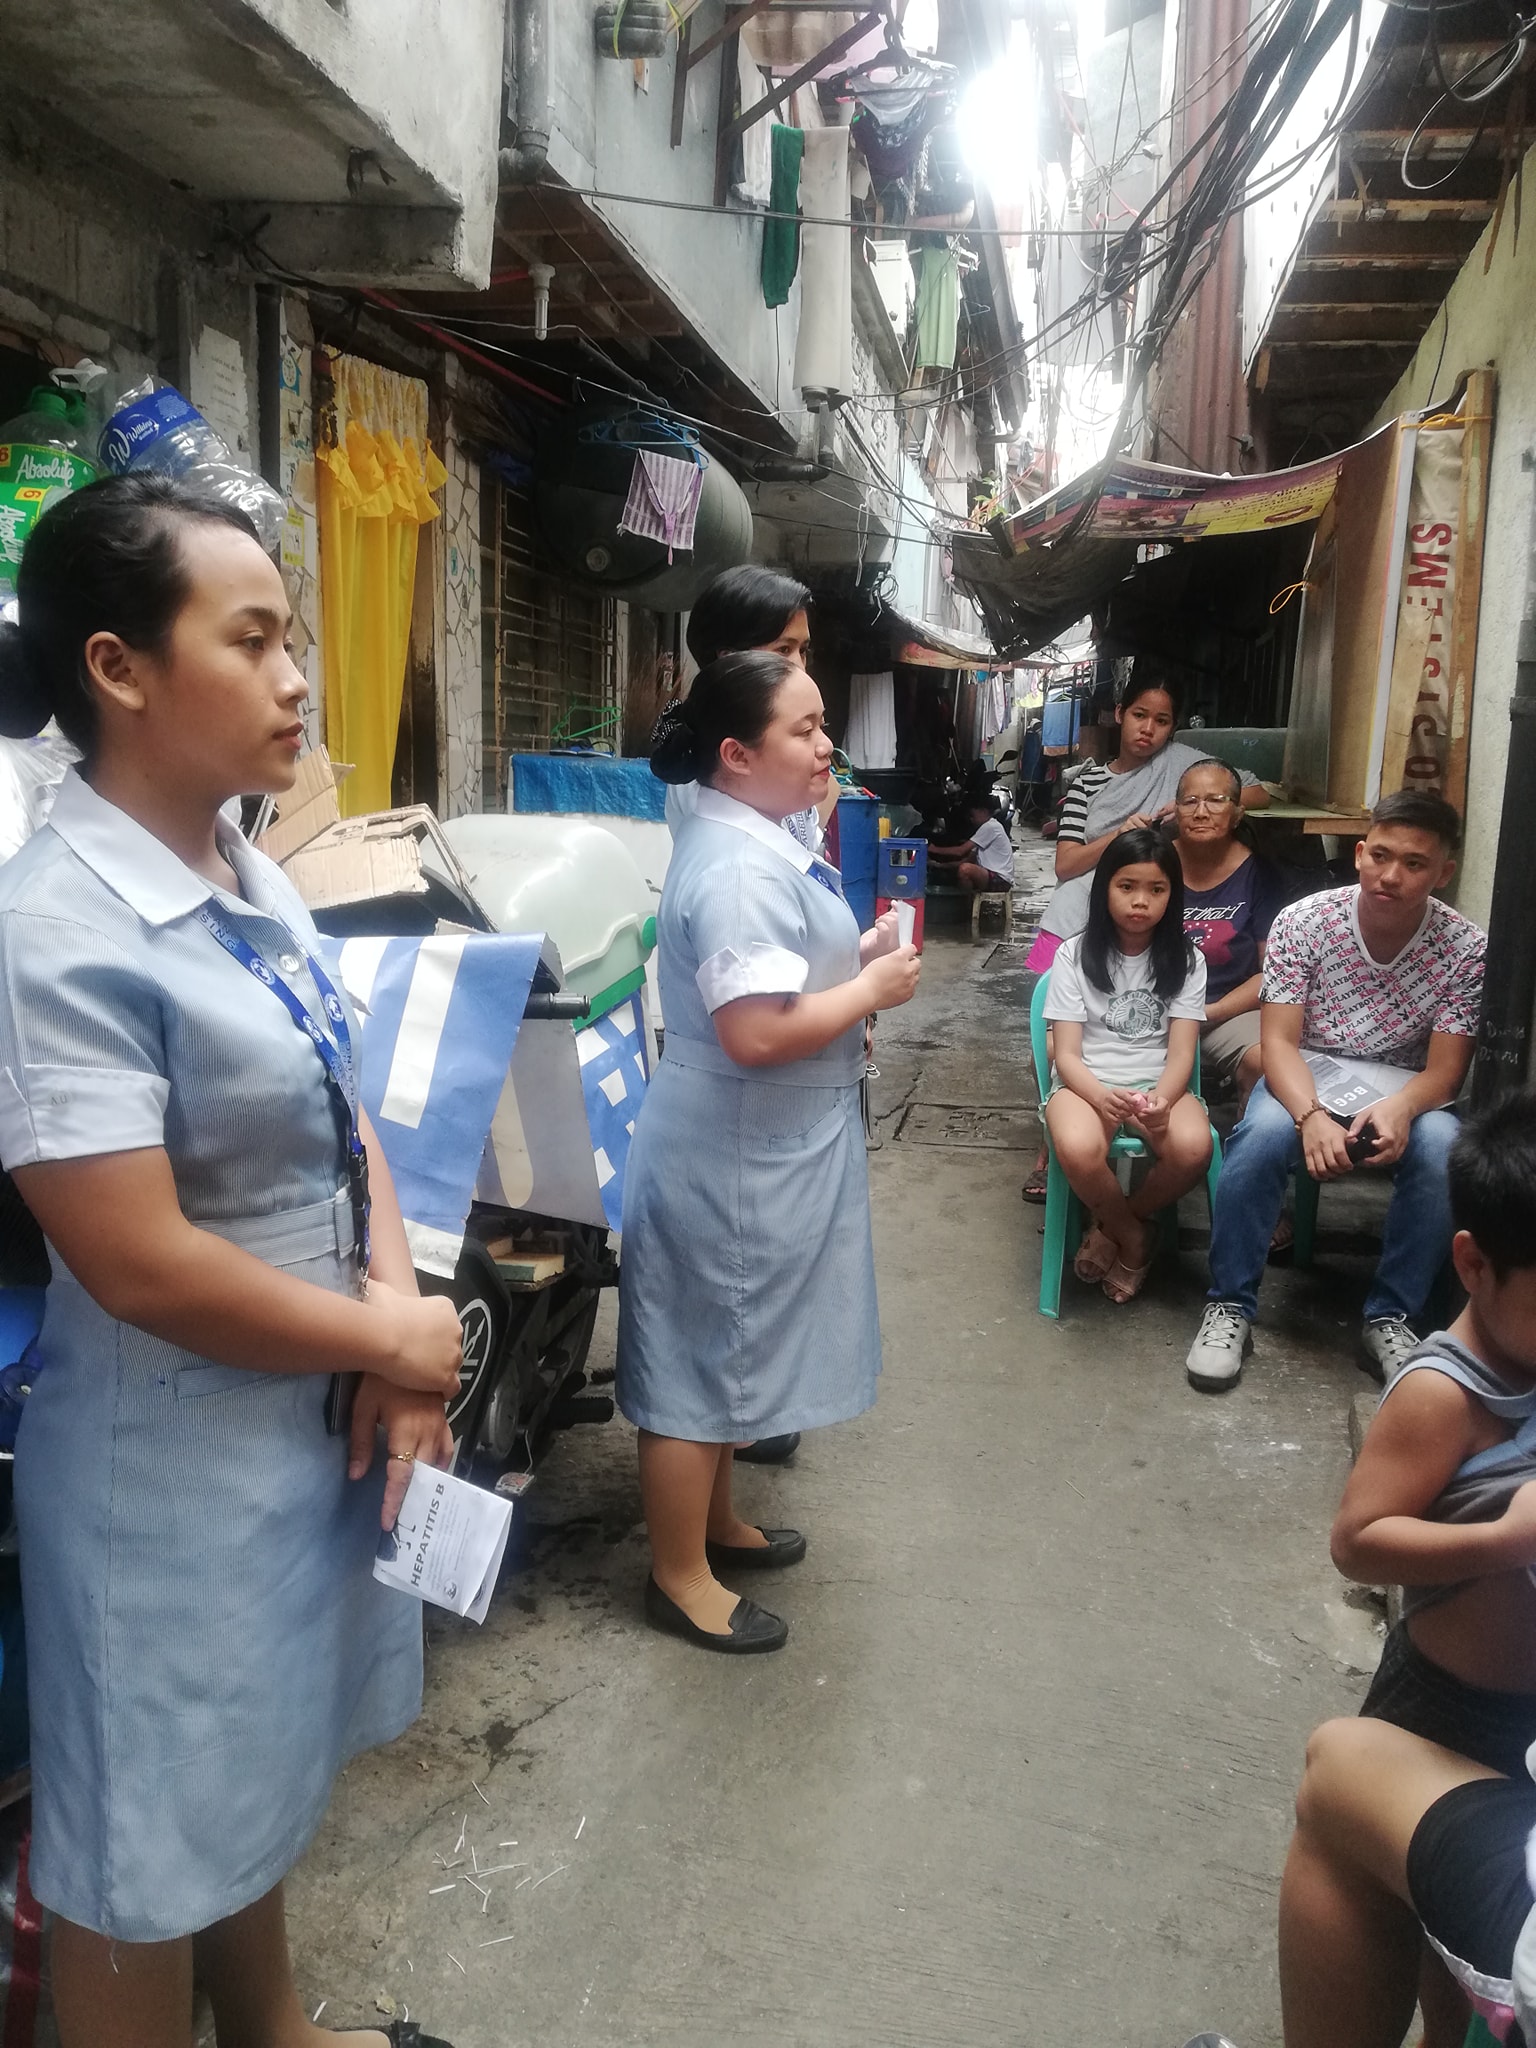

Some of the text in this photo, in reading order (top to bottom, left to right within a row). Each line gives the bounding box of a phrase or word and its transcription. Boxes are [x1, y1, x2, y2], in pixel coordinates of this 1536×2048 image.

[15, 454, 75, 489] Absolute
[1322, 917, 1342, 933] KISS
[1329, 931, 1350, 946] KISS
[1337, 946, 1357, 960] KISS
[1409, 944, 1429, 963] KISS
[1344, 960, 1364, 974] KISS
[1418, 956, 1439, 974] KISS
[1399, 969, 1434, 997] PLAYBOY
[1426, 969, 1446, 986] KISS
[1330, 983, 1366, 1004] PLAYBOY
[1338, 996, 1375, 1017] PLAYBOY
[1367, 996, 1386, 1011] KISS
[1346, 1008, 1380, 1030] PLAYBOY
[1373, 1007, 1394, 1024] KISS
[1437, 1016, 1457, 1030] KISS
[1353, 1019, 1389, 1043] PLAYBOY
[1382, 1018, 1403, 1034] KISS
[1363, 1029, 1399, 1053] PLAYBOY
[1333, 1086, 1368, 1107] BCG
[411, 1483, 445, 1587] HEPATITIS B
